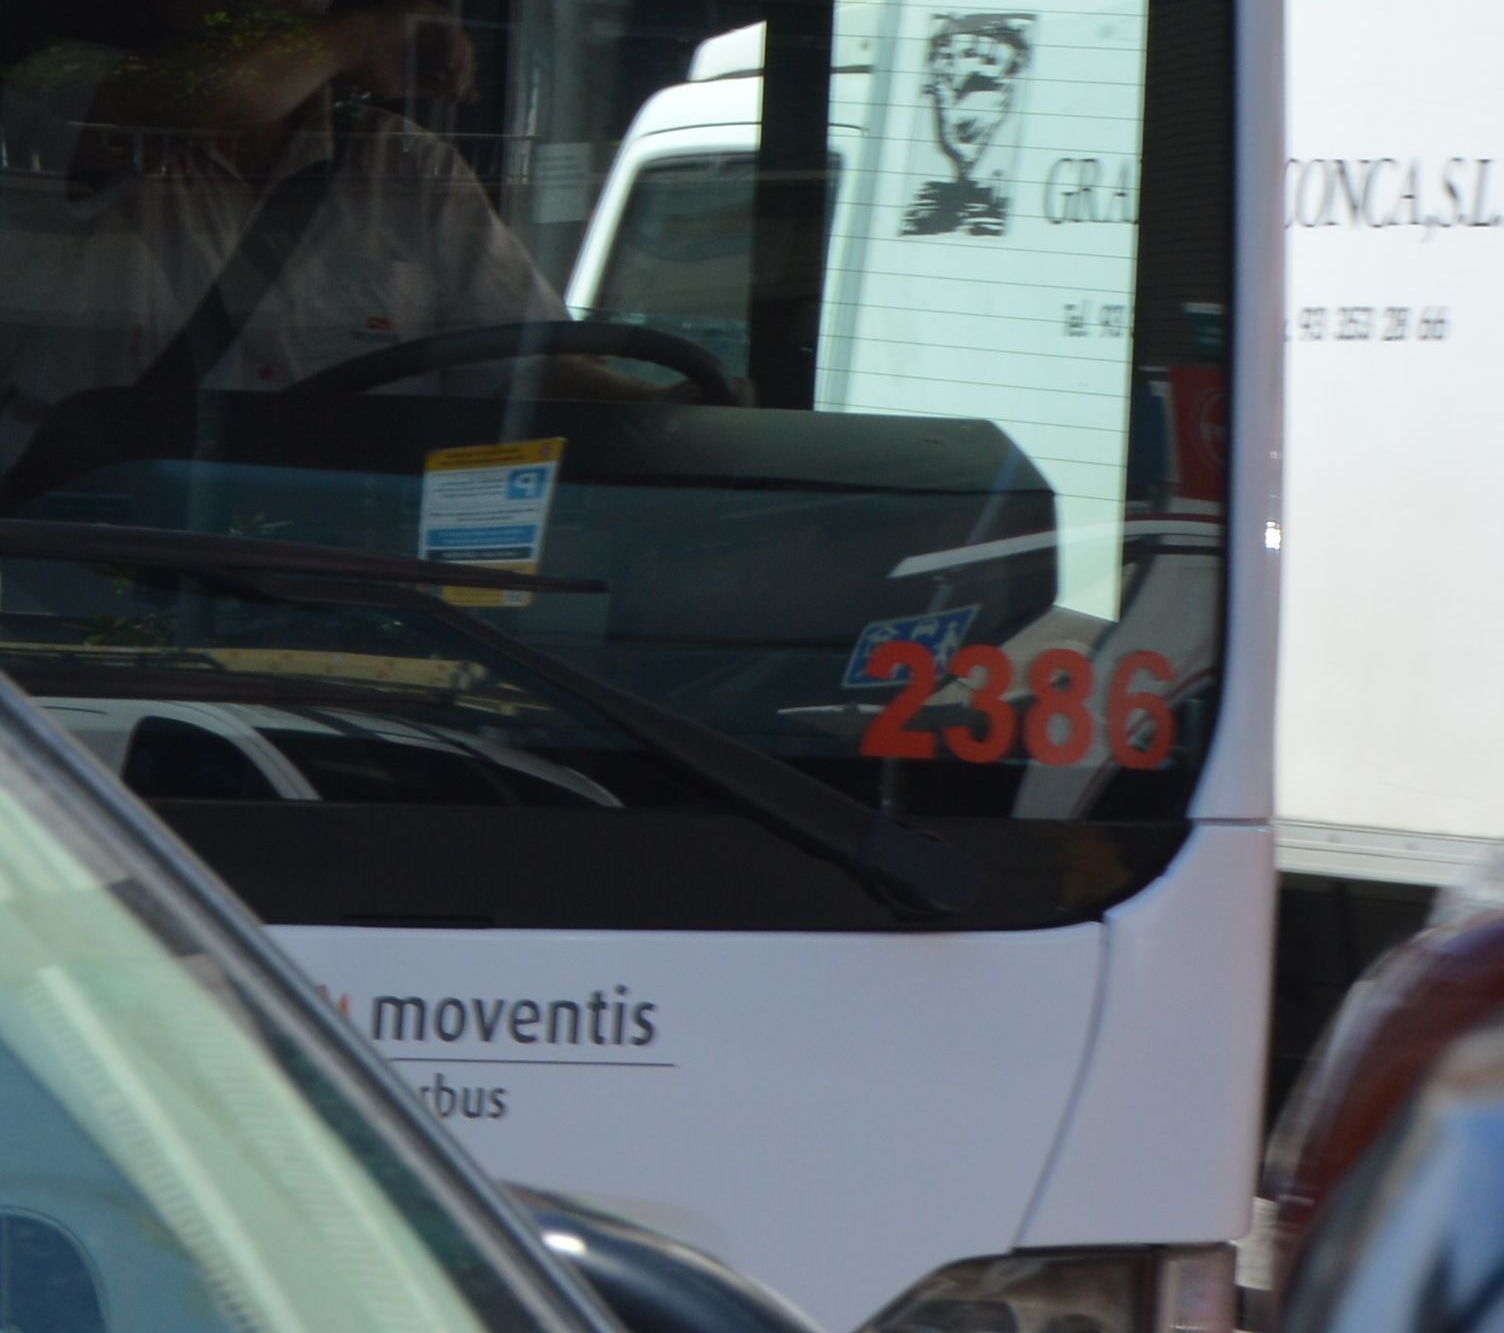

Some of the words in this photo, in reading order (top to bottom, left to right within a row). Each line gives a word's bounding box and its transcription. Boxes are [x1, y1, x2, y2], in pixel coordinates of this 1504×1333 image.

[1045, 156, 1141, 225] GRA
[860, 639, 1176, 771] 2386
[371, 983, 658, 1047] moventis
